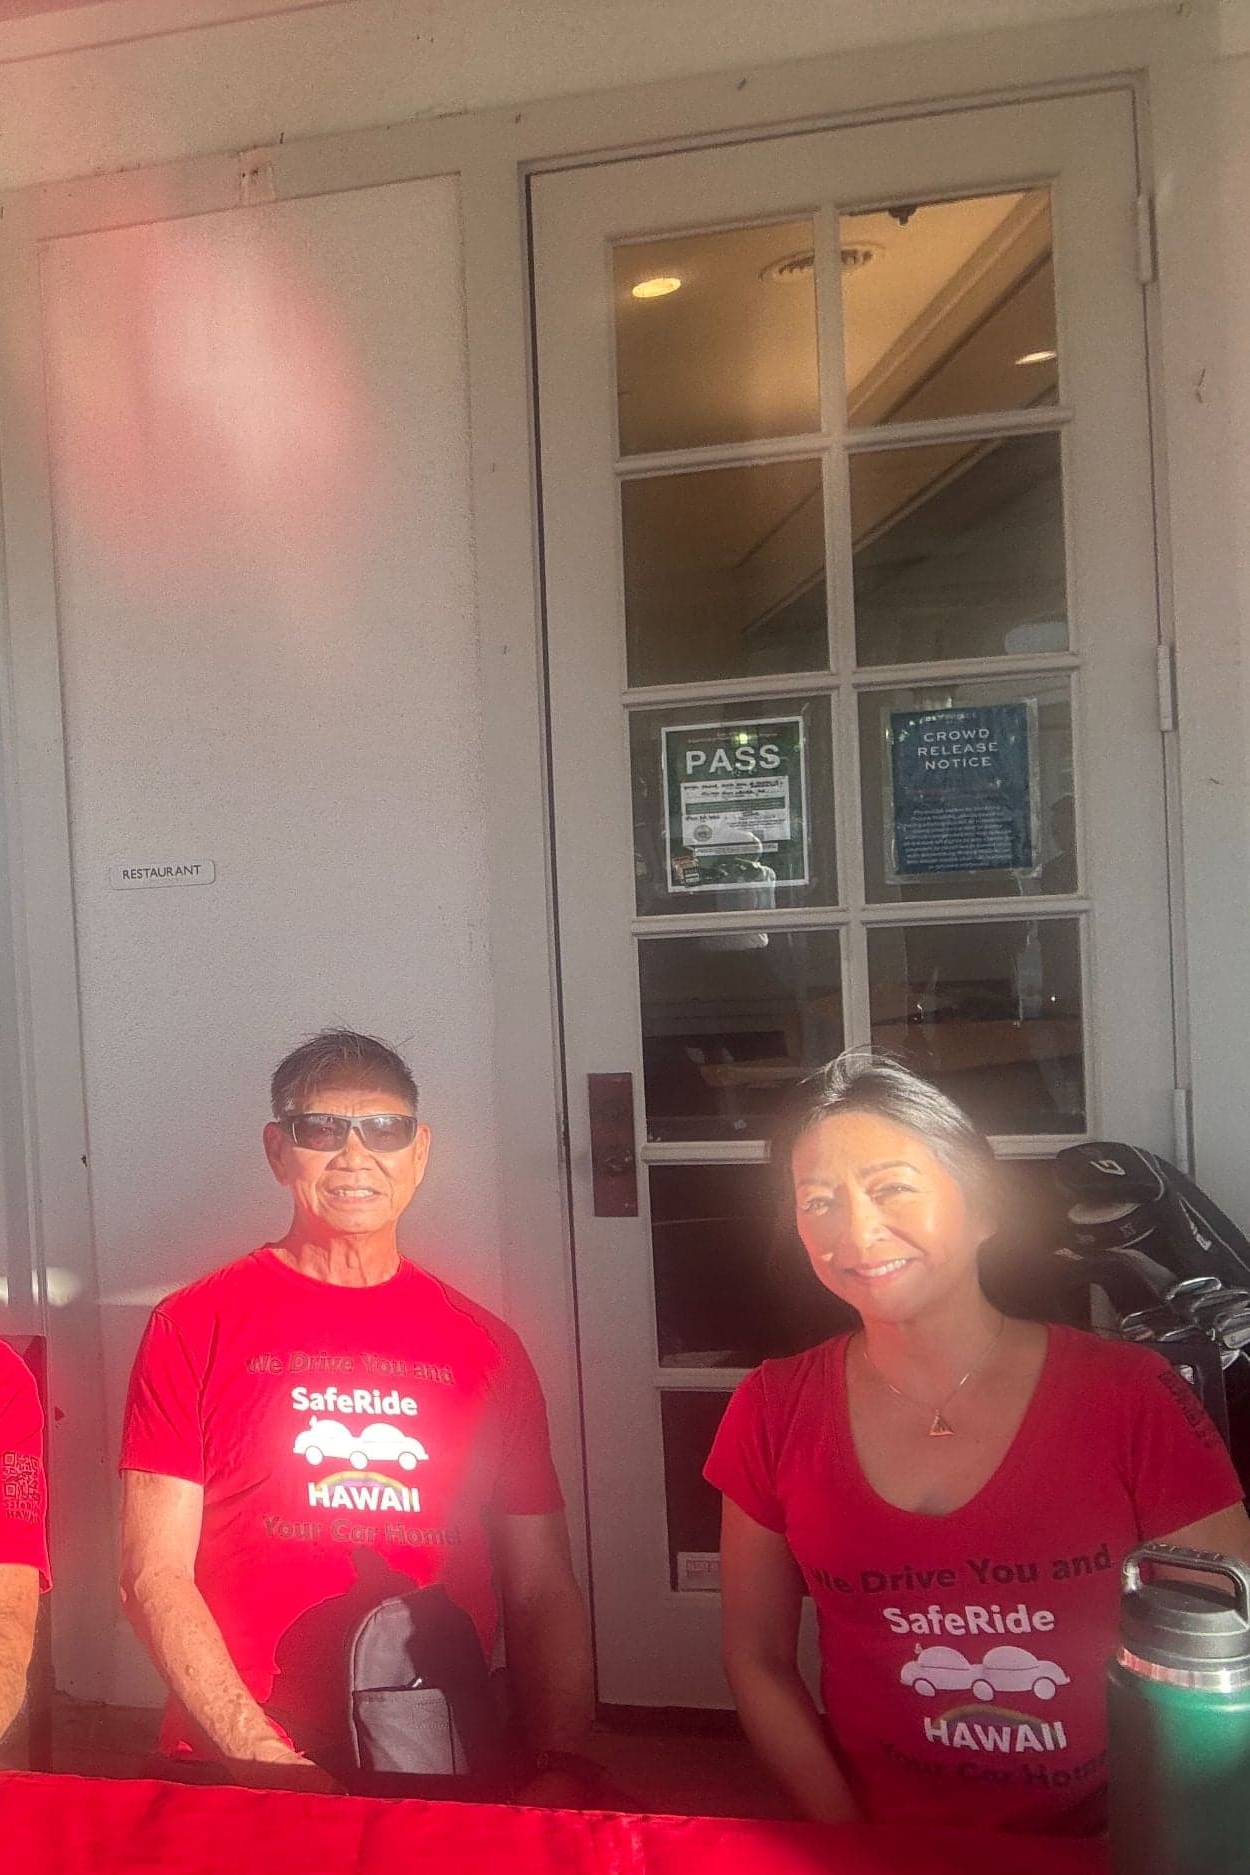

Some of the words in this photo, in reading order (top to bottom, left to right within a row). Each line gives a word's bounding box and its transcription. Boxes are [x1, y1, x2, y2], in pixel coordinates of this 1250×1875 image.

[917, 742, 999, 757] RELEASE
[923, 728, 990, 743] CROWD
[685, 744, 781, 775] PASS
[925, 757, 992, 770] NOTICE
[122, 864, 202, 880] RESTAURANT
[247, 1353, 283, 1376] We
[290, 1352, 354, 1373] Drive
[360, 1353, 406, 1378] You
[413, 1362, 455, 1384] and
[291, 1386, 419, 1416] SafeRide
[307, 1482, 421, 1513] HAWAII
[262, 1515, 322, 1540] Your
[331, 1518, 377, 1544] Car
[860, 1563, 957, 1594] Drive
[966, 1557, 1040, 1585] You
[1052, 1543, 1112, 1581] and
[882, 1604, 1056, 1636] SafeRide
[923, 1716, 1068, 1754] HAWAII
